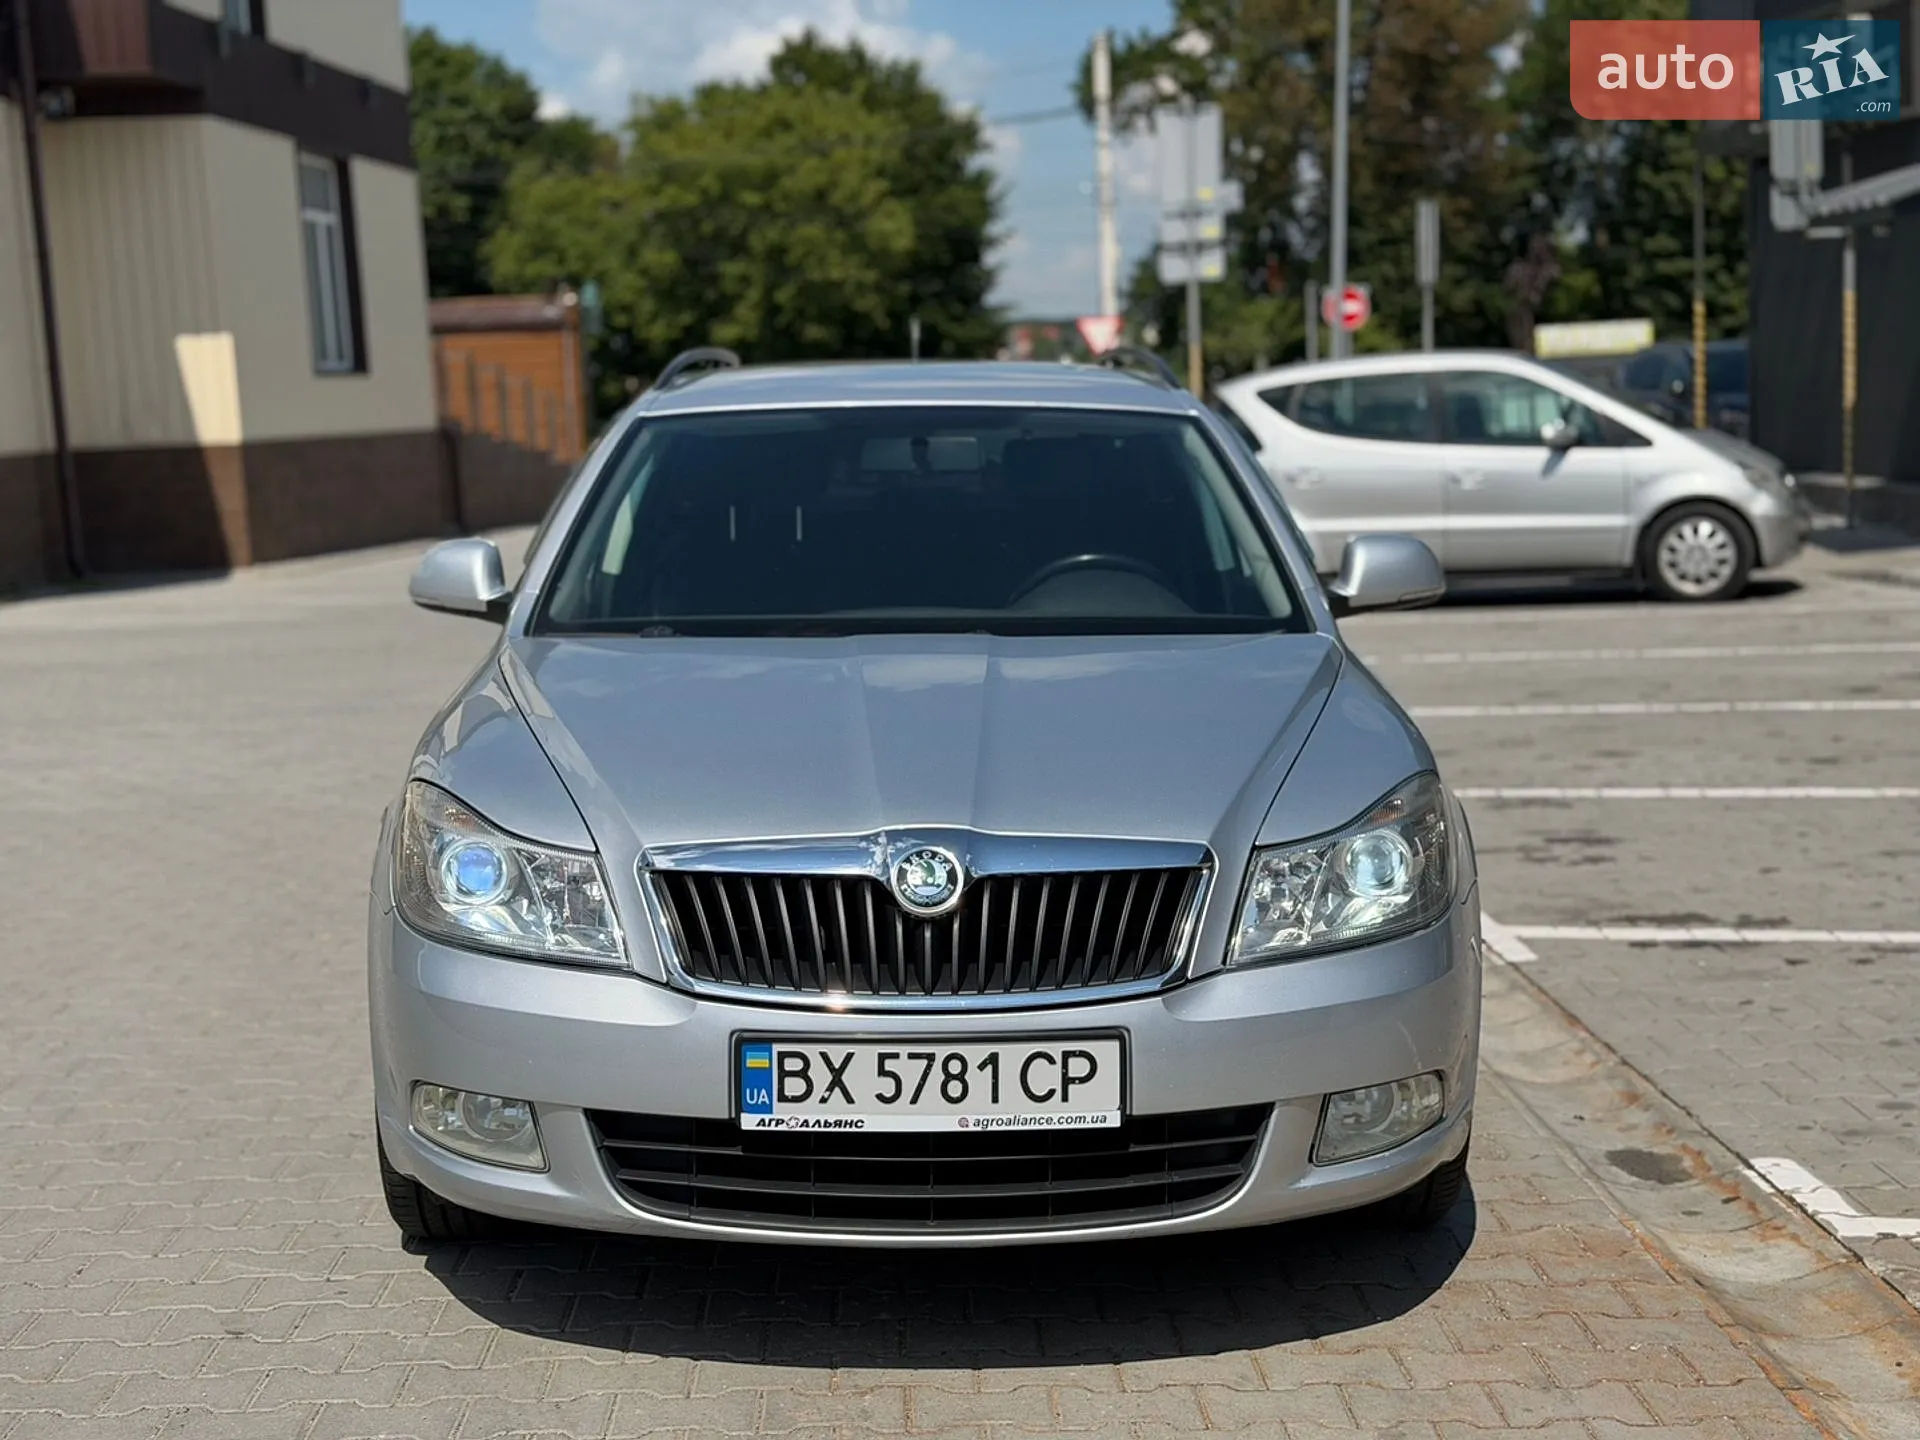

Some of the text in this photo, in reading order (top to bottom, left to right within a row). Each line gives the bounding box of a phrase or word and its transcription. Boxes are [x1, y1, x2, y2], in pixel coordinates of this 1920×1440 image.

[777, 1050, 1098, 1104] BX 5781 CP
[746, 1088, 769, 1104] UA
[973, 1114, 1107, 1129] agroaliance.com.ua
